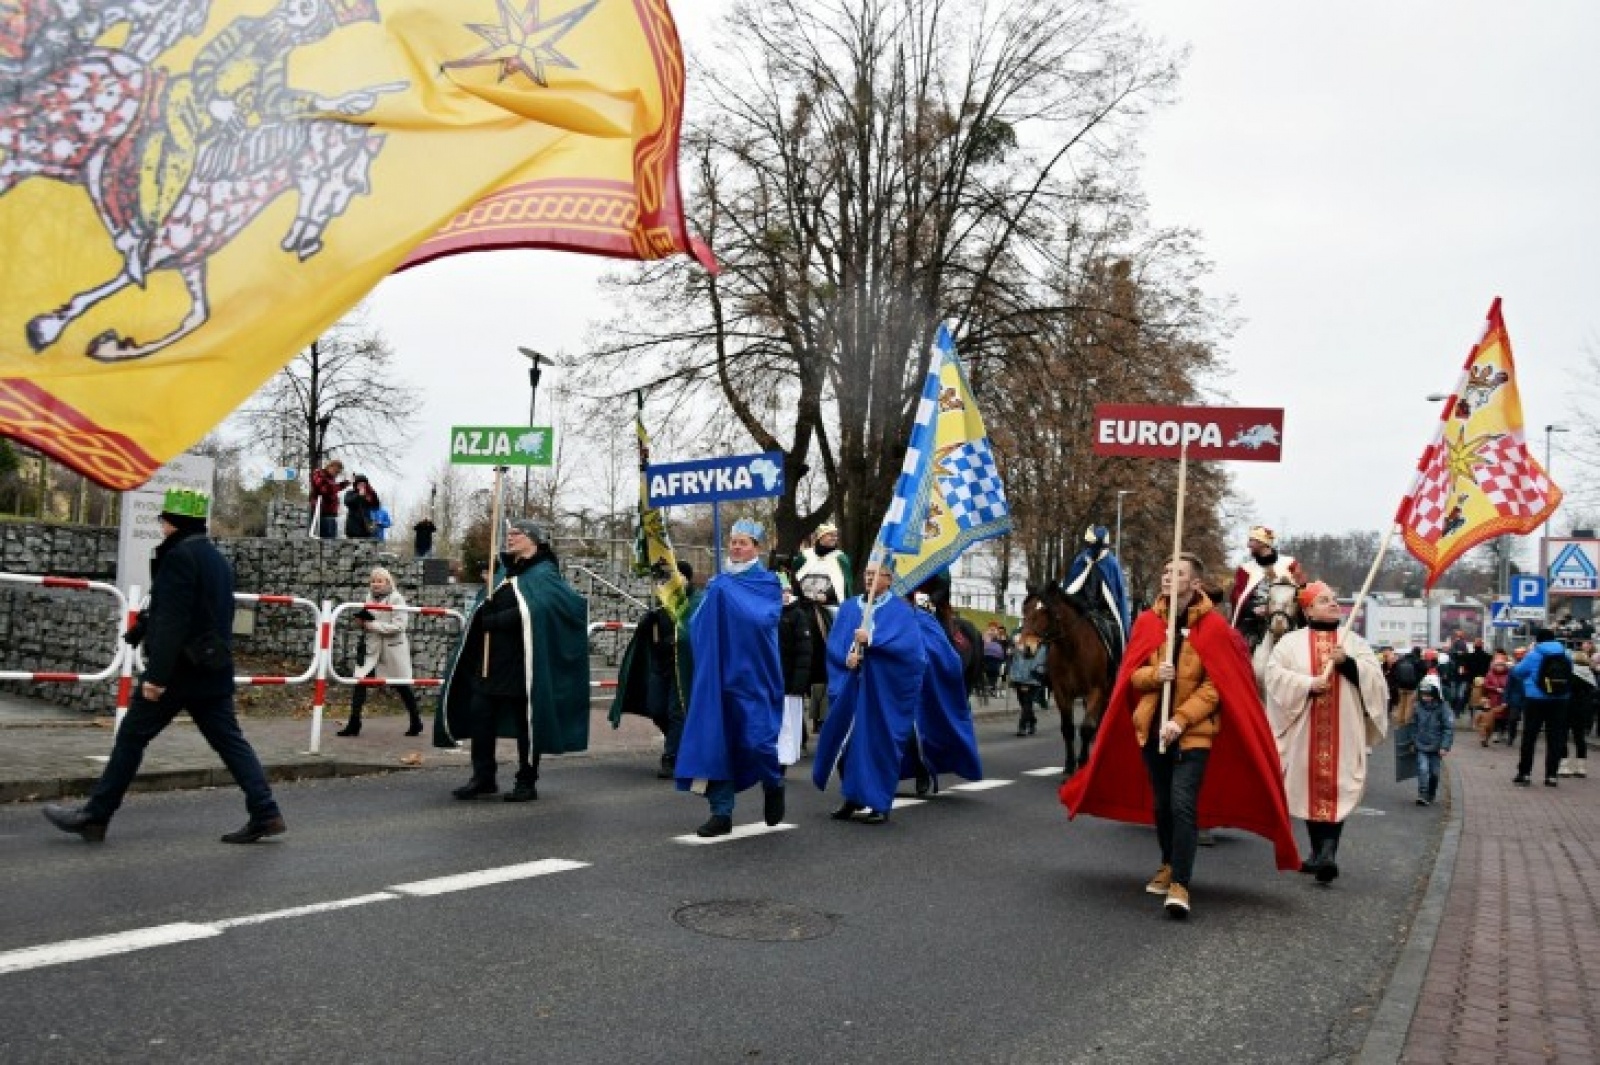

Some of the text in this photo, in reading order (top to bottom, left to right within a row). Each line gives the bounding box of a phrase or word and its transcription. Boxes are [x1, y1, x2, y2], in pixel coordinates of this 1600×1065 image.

[453, 431, 511, 456] AZJA
[1099, 420, 1222, 447] EUROPA
[650, 466, 752, 498] AFRYKA
[1519, 579, 1540, 603] P
[1550, 577, 1593, 589] ALDI
